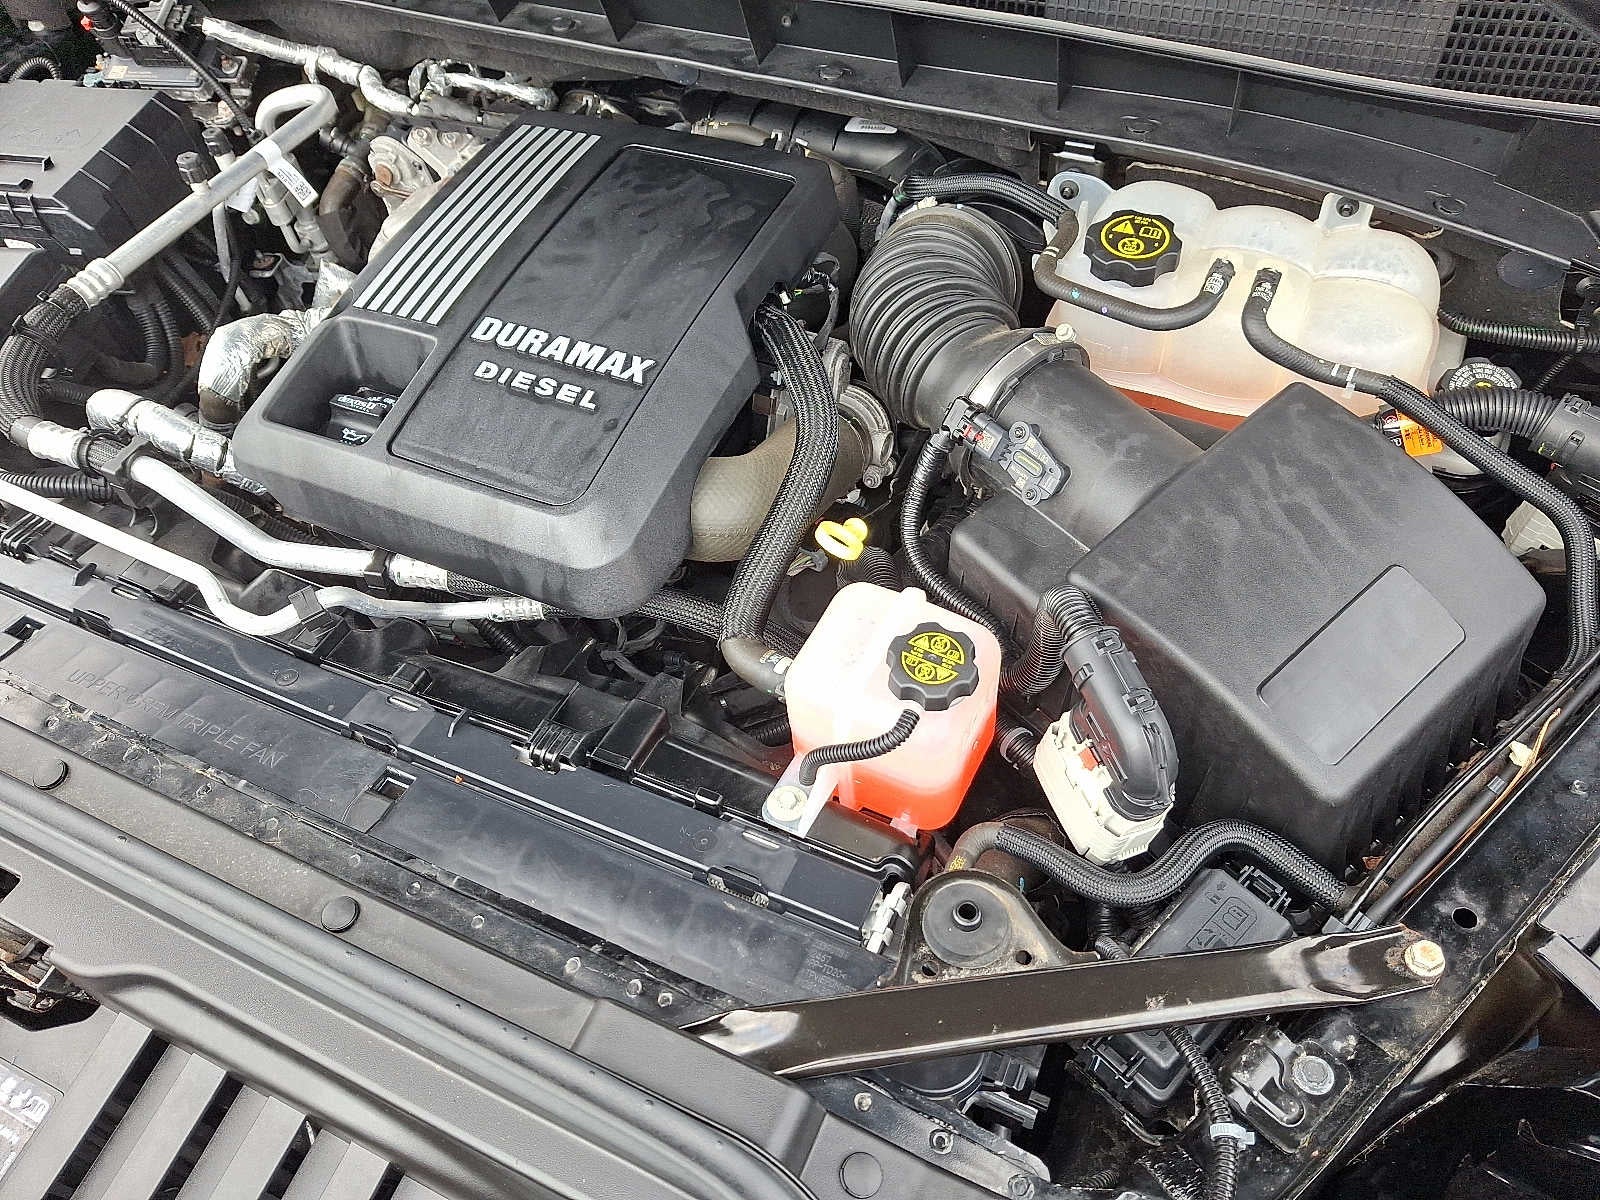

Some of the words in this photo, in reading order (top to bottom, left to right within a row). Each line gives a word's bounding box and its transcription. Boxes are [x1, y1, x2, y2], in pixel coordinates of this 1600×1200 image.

[470, 316, 657, 387] DURAMAX
[473, 360, 597, 413] DIESEL
[69, 669, 126, 704] UPPER
[176, 712, 246, 752] TRIPLE
[240, 741, 289, 769] FAN
